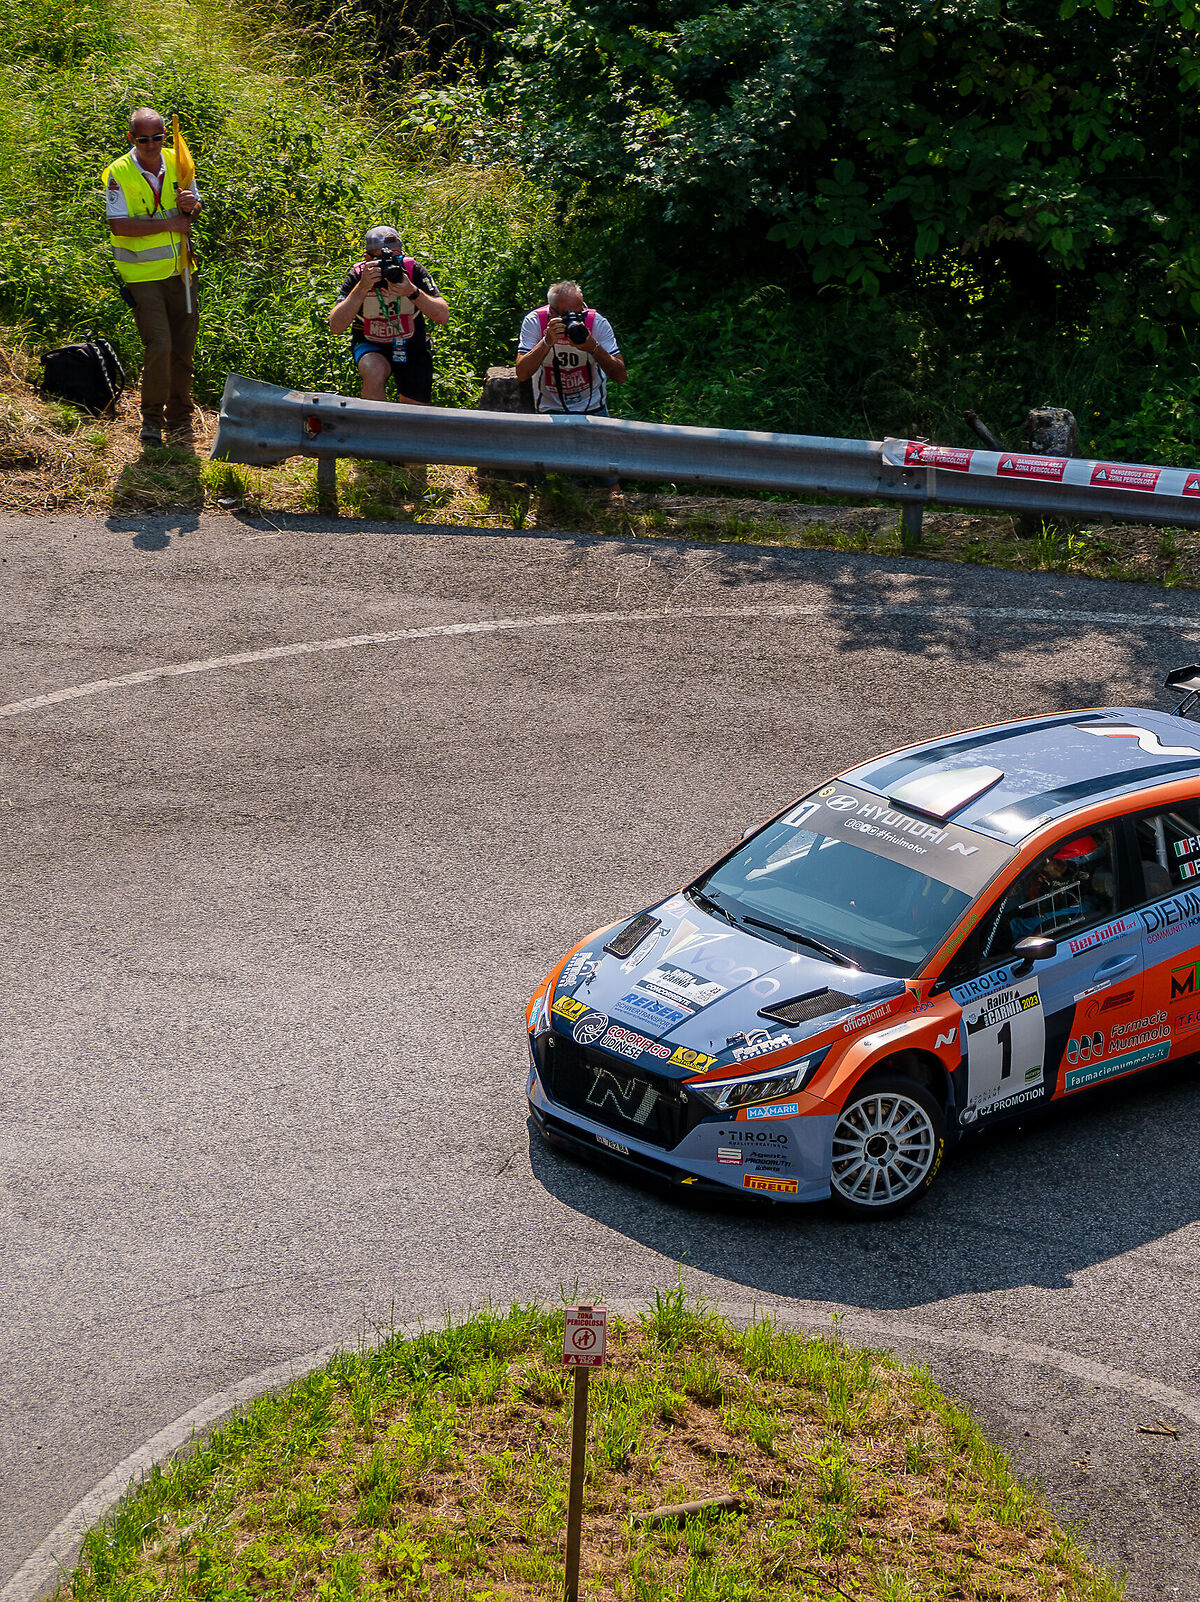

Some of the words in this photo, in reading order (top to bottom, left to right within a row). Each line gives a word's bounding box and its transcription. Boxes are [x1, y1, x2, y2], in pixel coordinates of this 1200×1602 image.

[557, 352, 579, 367] 30
[1123, 476, 1154, 485] PERICOLOSA
[856, 803, 949, 845] HYUNDAI
[876, 830, 927, 855] #friulmotor
[1069, 920, 1126, 953] Bertoldi
[1146, 921, 1188, 944] COMMUNITY
[955, 970, 1007, 999] TIROLO
[552, 995, 590, 1018] KOPY
[621, 993, 684, 1022] REISER
[989, 999, 1023, 1026] CARNIA
[1021, 994, 1039, 1010] 2023
[1111, 1010, 1168, 1038] Farmacie
[600, 1035, 642, 1060] UDINESE
[607, 1025, 671, 1058] COLORIFICIO
[996, 1020, 1013, 1081] 1
[1108, 1024, 1171, 1053] Mummolo
[671, 1046, 718, 1070] KOPY
[1071, 1049, 1165, 1086] farmaciemummolo.it
[749, 1105, 796, 1117] MAXMARK
[980, 1105, 992, 1116] CZ
[993, 1087, 1045, 1112] PROMOTION
[728, 1131, 788, 1144] TIROLO
[744, 1174, 798, 1193] PIRELLI
[567, 1319, 604, 1327] PERICOLOSA
